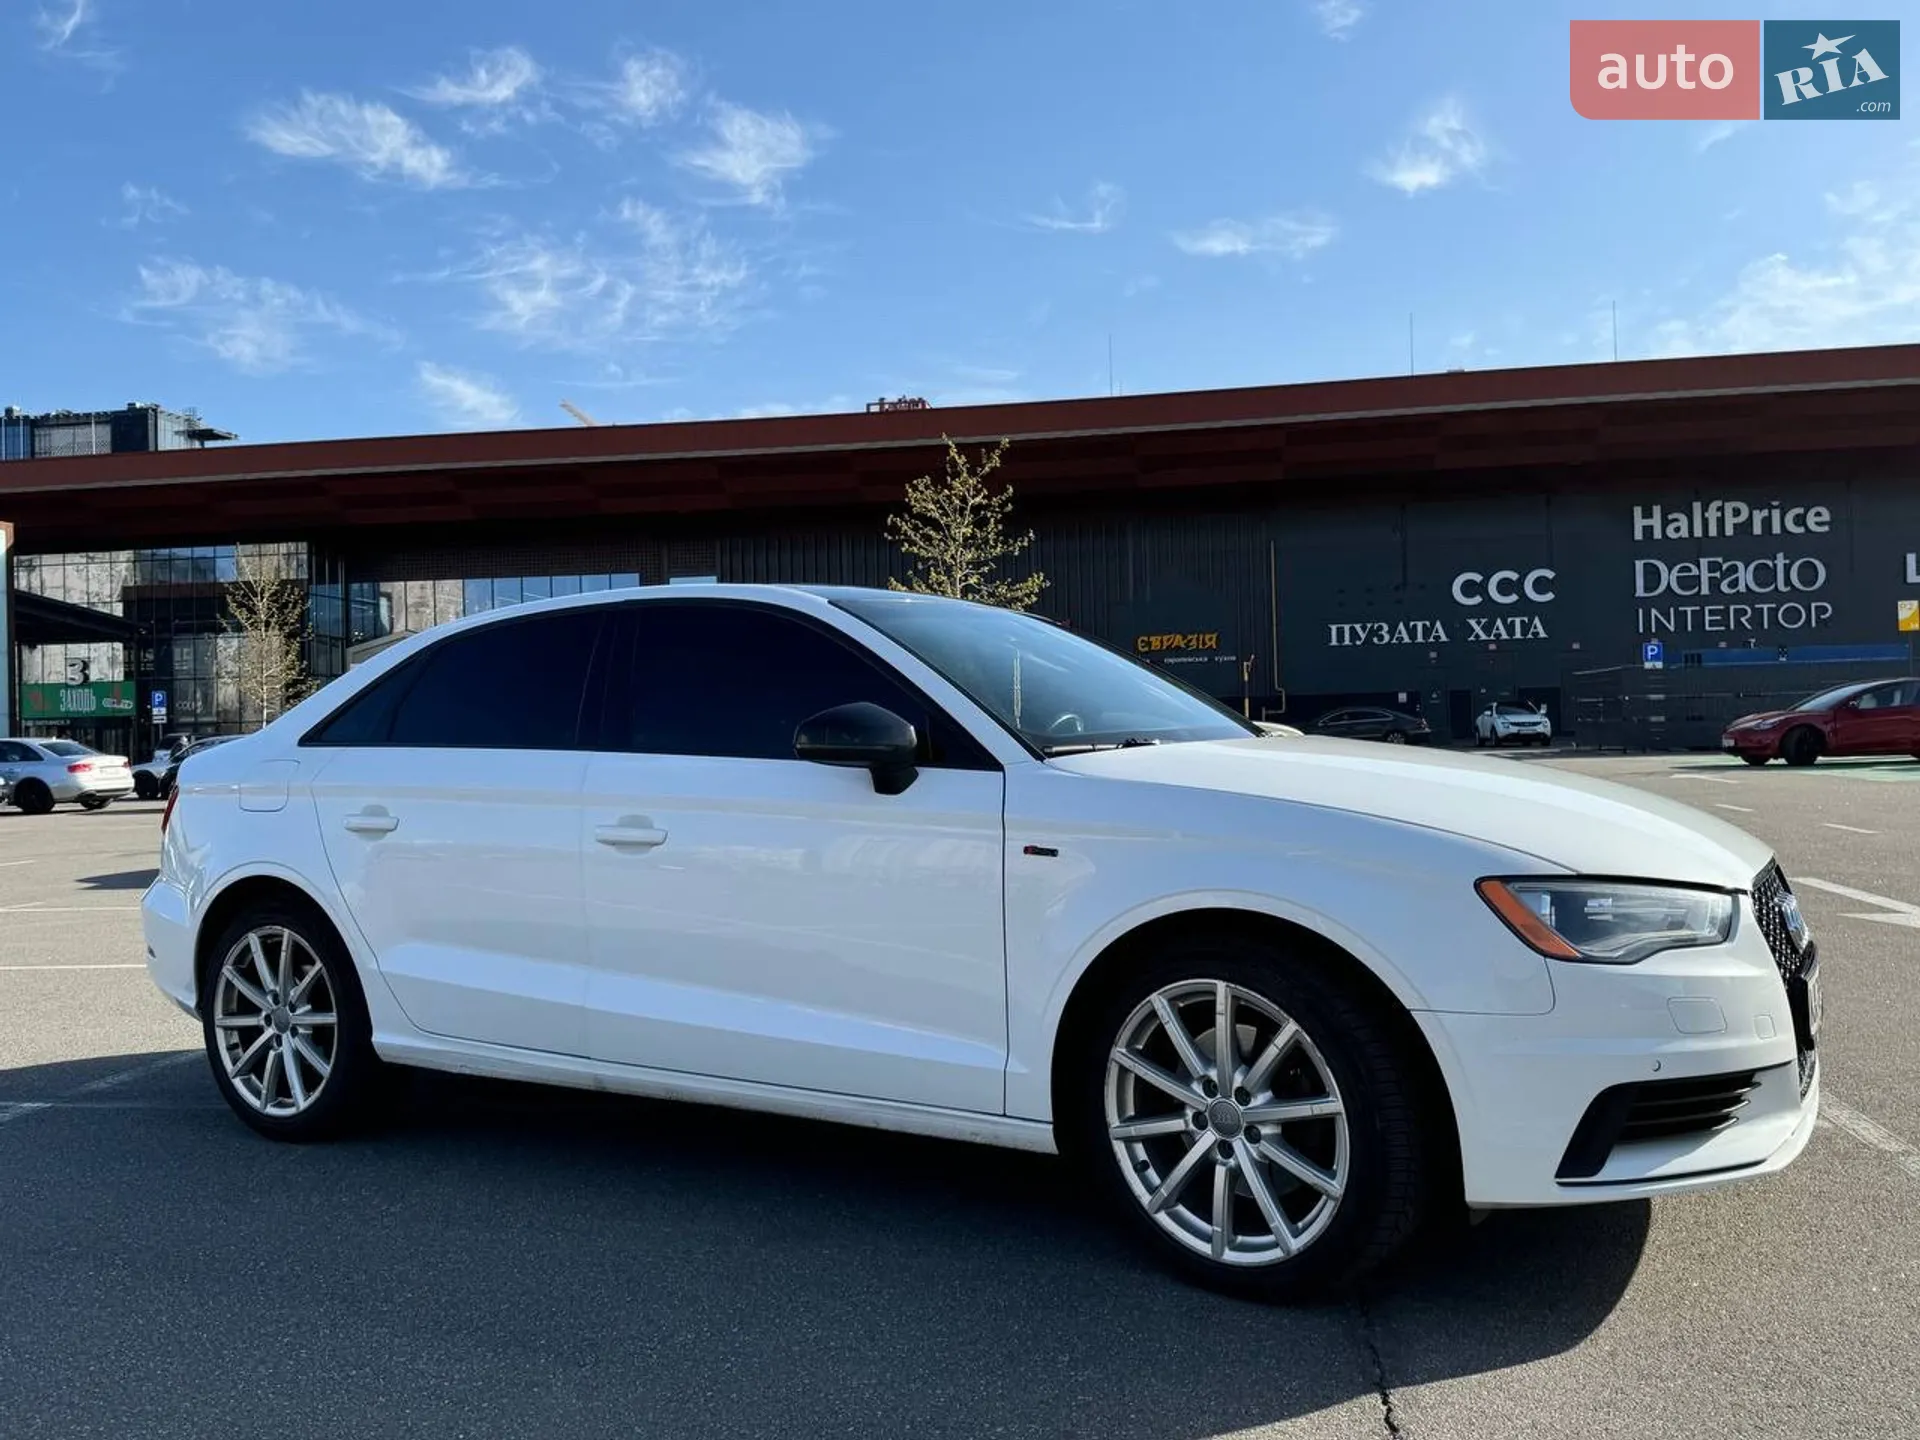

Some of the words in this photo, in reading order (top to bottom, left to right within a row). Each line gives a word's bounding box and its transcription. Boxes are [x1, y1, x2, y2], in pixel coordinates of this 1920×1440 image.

[1633, 500, 1832, 541] HalfPrice
[1451, 568, 1557, 606] CCC
[1634, 552, 1827, 598] DeFacto
[1328, 619, 1450, 646] ПУЗАТА
[1466, 615, 1549, 641] ХАТА
[1638, 601, 1833, 634] INTERTOP
[1137, 633, 1218, 652] ЄВРАЗІЯ
[1647, 645, 1659, 660] P
[66, 658, 85, 685] 3
[154, 693, 163, 705] P
